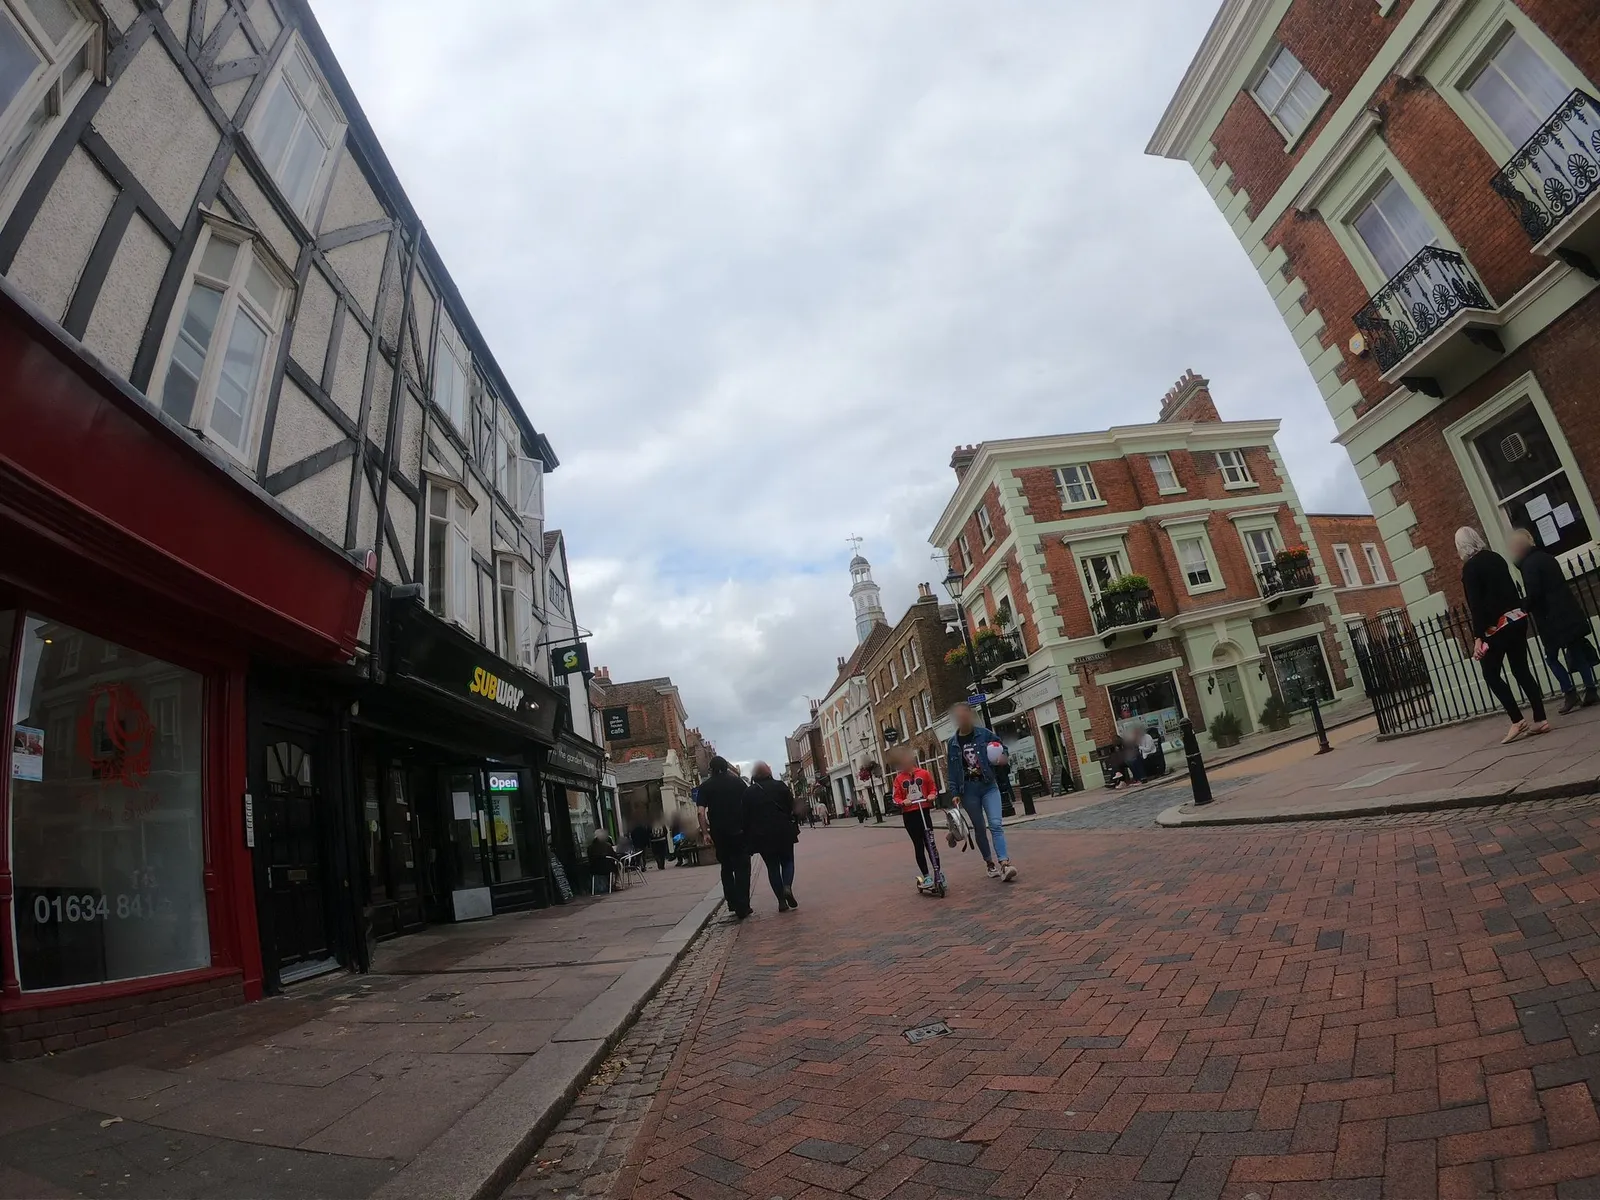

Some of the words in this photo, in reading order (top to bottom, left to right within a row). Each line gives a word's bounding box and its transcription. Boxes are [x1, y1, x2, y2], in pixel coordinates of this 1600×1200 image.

[470, 666, 523, 711] SUBWAY
[567, 752, 583, 765] garden
[489, 776, 517, 790] Open
[34, 894, 110, 923] 01634
